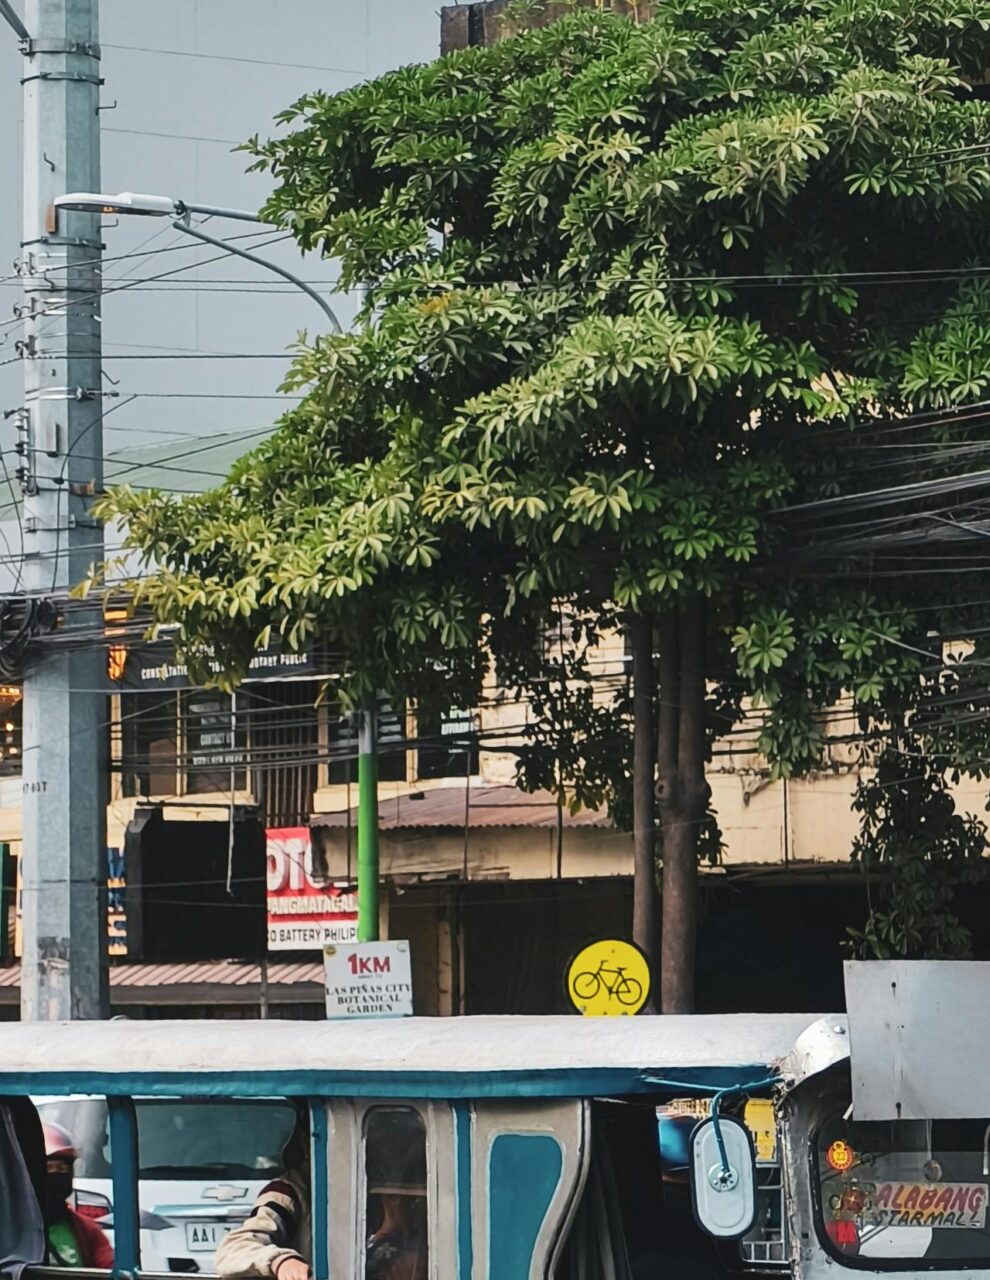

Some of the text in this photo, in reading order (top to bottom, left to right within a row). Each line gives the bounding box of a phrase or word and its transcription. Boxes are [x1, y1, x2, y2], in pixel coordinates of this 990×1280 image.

[280, 653, 308, 665] PUBLIC
[280, 928, 320, 942] BATTERY
[324, 927, 357, 941] PHILIP
[326, 983, 410, 995] LAS PIÑAS CITY
[337, 993, 401, 1005] BOTANICAL
[347, 1004, 393, 1014] GARDEN
[875, 1184, 985, 1212] ALABANG
